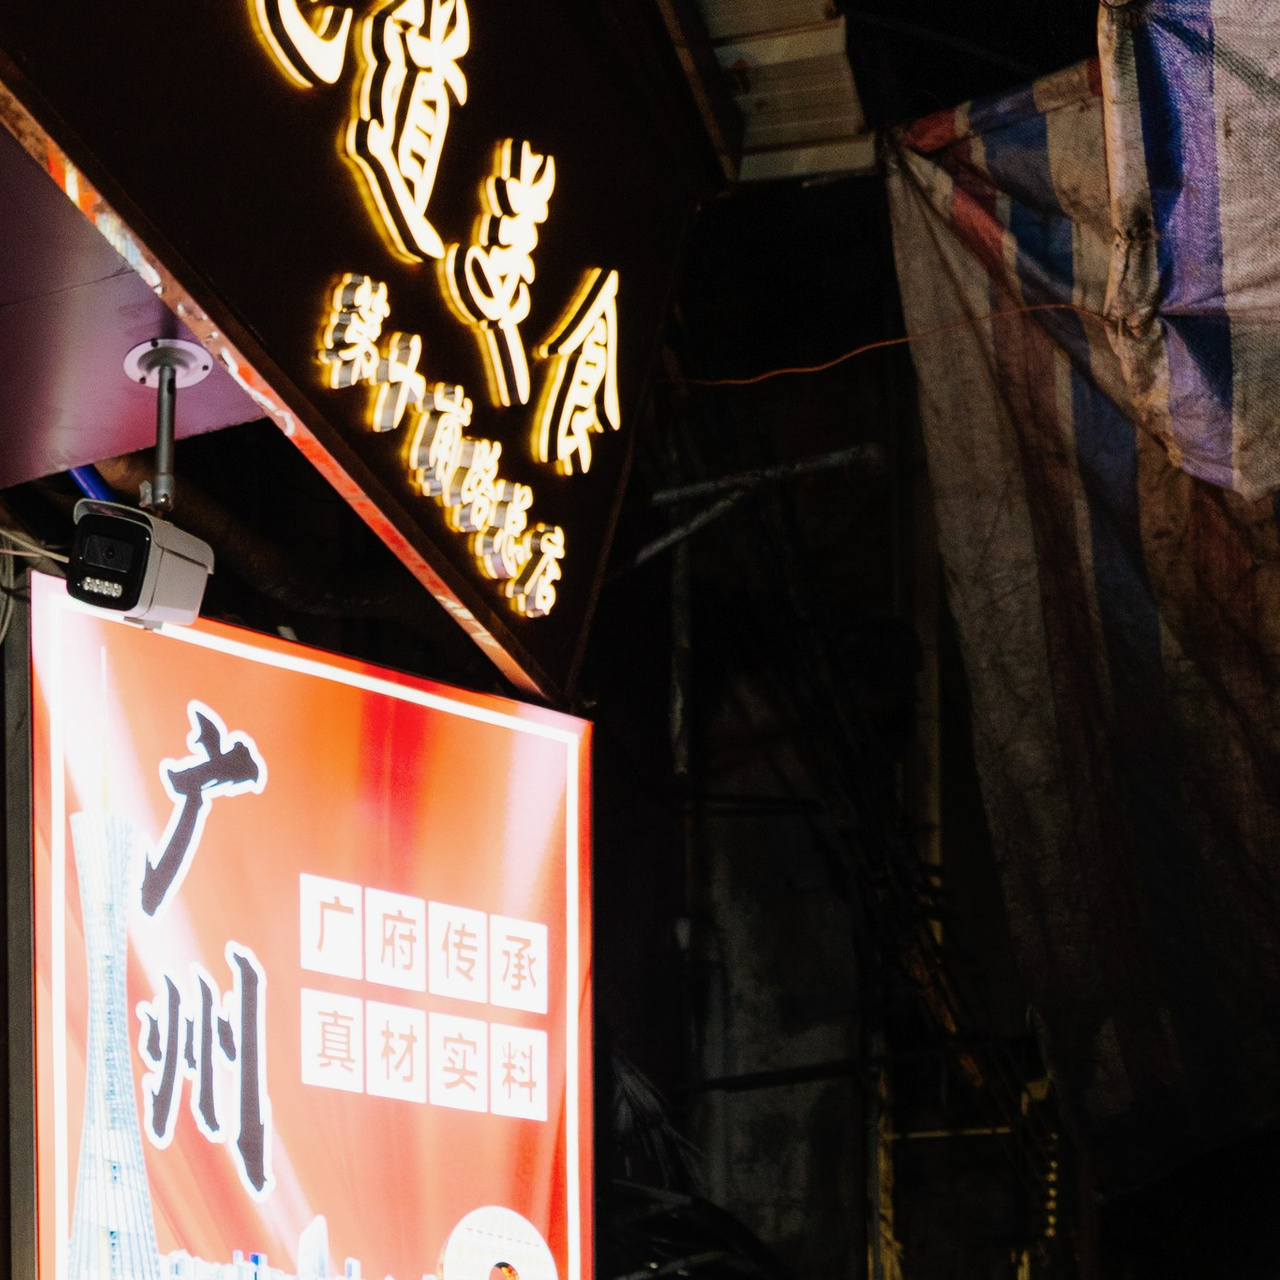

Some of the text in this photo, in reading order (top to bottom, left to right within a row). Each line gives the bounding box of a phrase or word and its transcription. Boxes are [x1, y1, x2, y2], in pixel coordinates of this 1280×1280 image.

[140, 708, 269, 1193] 广州
[316, 895, 538, 992] 广府传承
[316, 1009, 538, 1104] 真材实料
